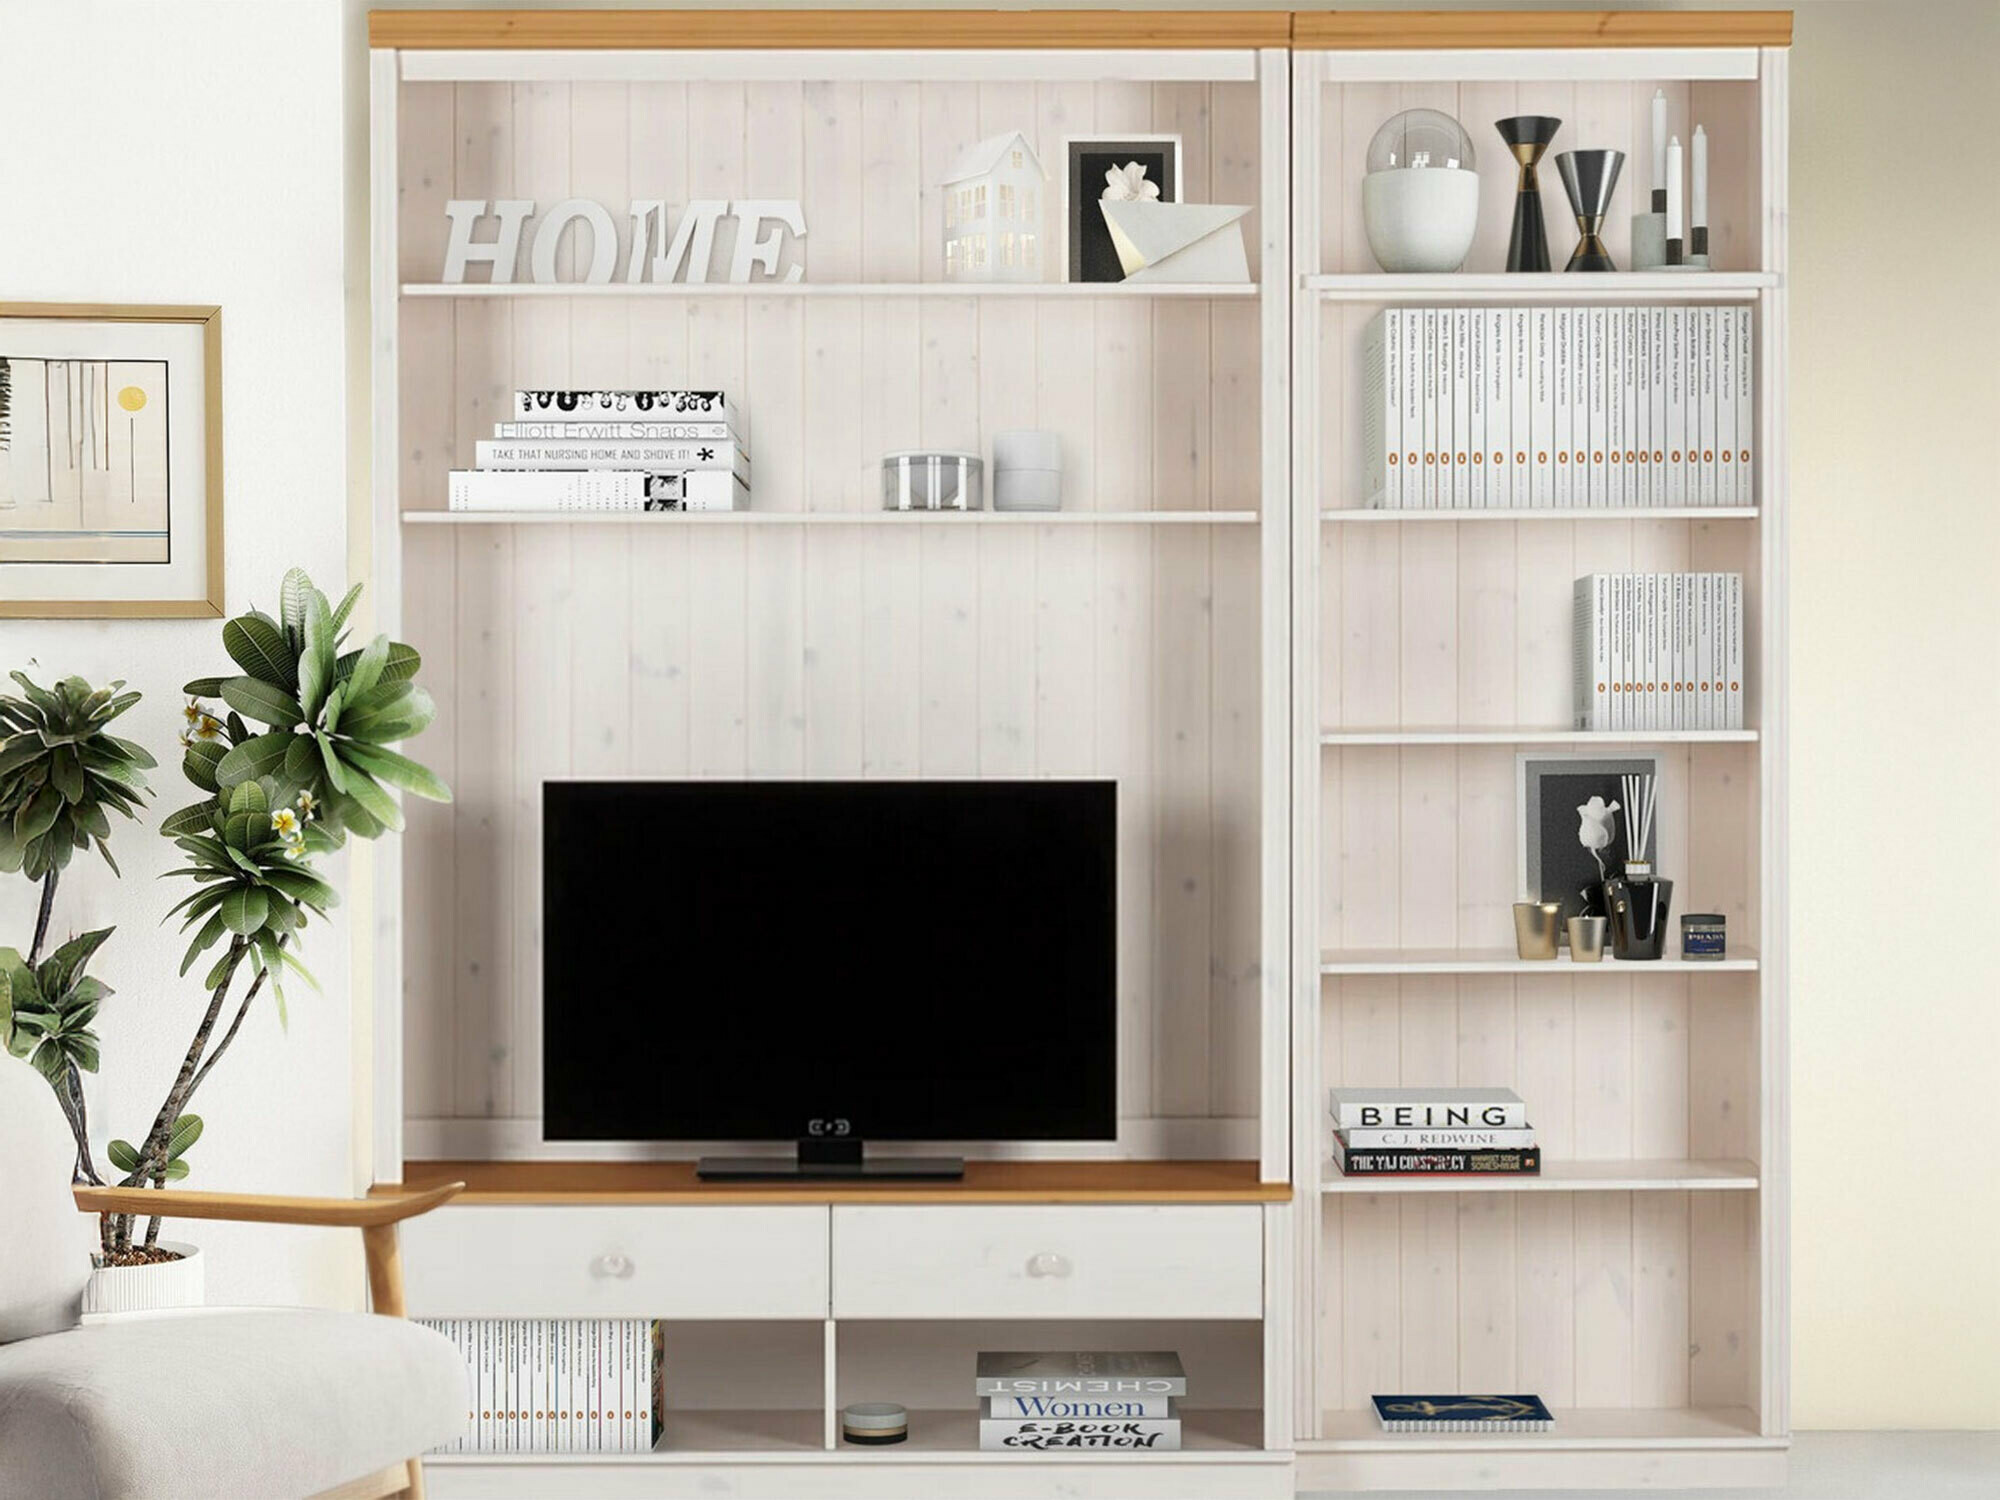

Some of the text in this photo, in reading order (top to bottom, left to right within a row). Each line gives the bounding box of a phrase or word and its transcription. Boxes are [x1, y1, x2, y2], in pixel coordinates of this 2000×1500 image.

[442, 200, 808, 283] HOME
[501, 423, 698, 439] Elliott Erwitt Snaps
[492, 449, 690, 460] TAKE THAT NURSING HOME AND SHOVE IT!
[1362, 1107, 1506, 1126] BEING
[1382, 1134, 1497, 1144] C. J. REDWINE
[1351, 1155, 1373, 1170] THE
[988, 1381, 1172, 1392] CHEMIST
[1014, 1396, 1146, 1416] Women
[1018, 1424, 1146, 1434] E-BOOK
[1004, 1432, 1164, 1450] CREATION
